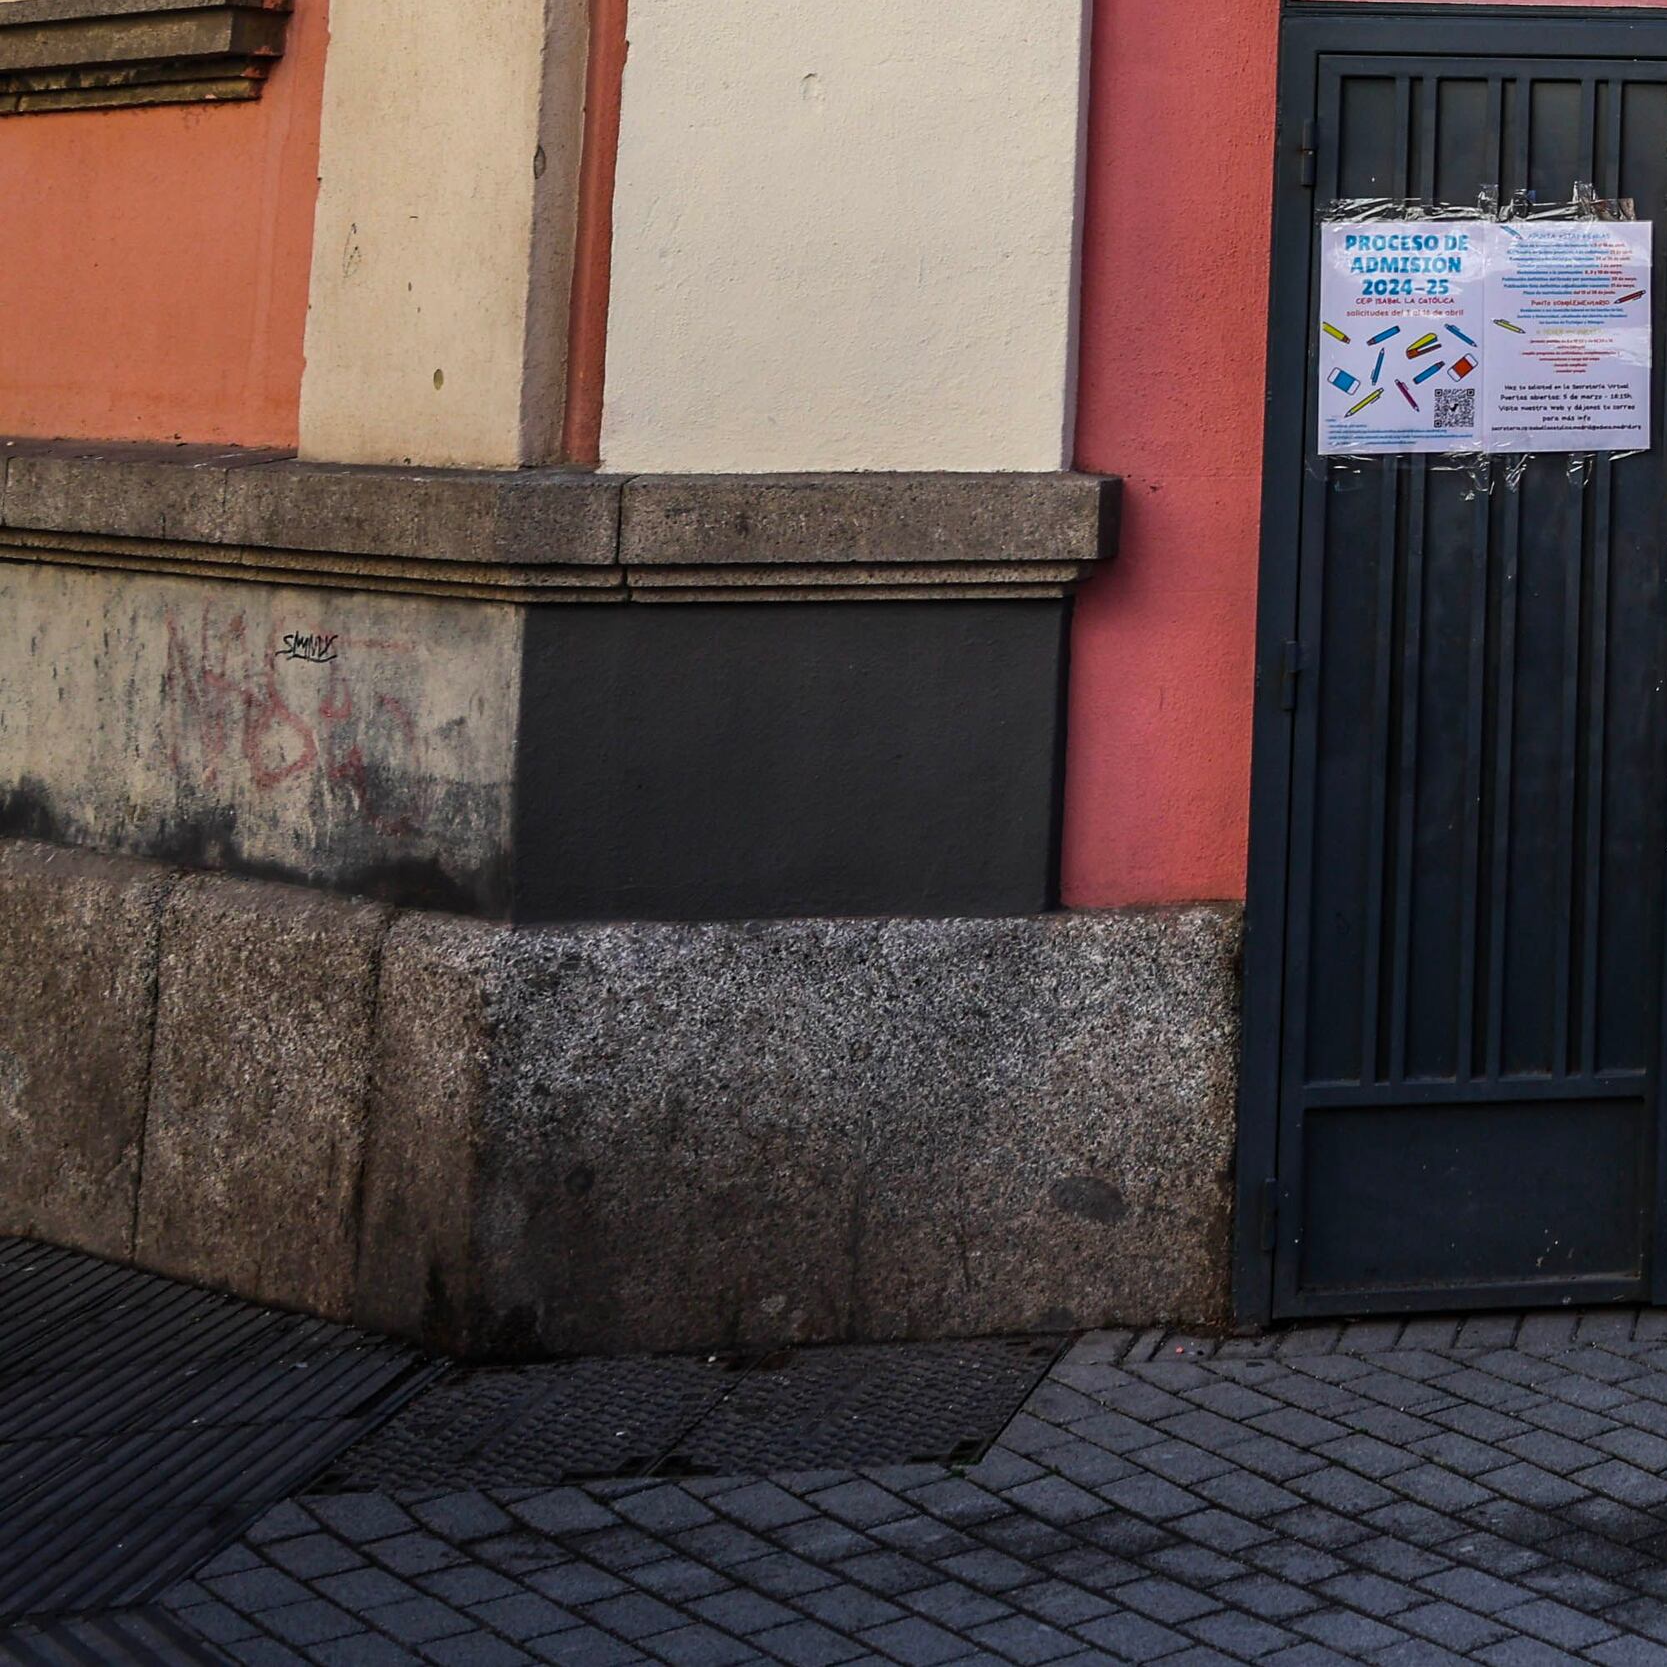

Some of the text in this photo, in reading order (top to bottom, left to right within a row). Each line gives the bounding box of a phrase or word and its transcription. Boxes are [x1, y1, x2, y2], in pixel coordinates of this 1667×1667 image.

[1345, 234, 1469, 251] PROCESO DE
[1350, 253, 1462, 273] ADMISIÓN
[1362, 278, 1450, 295] 2024-25
